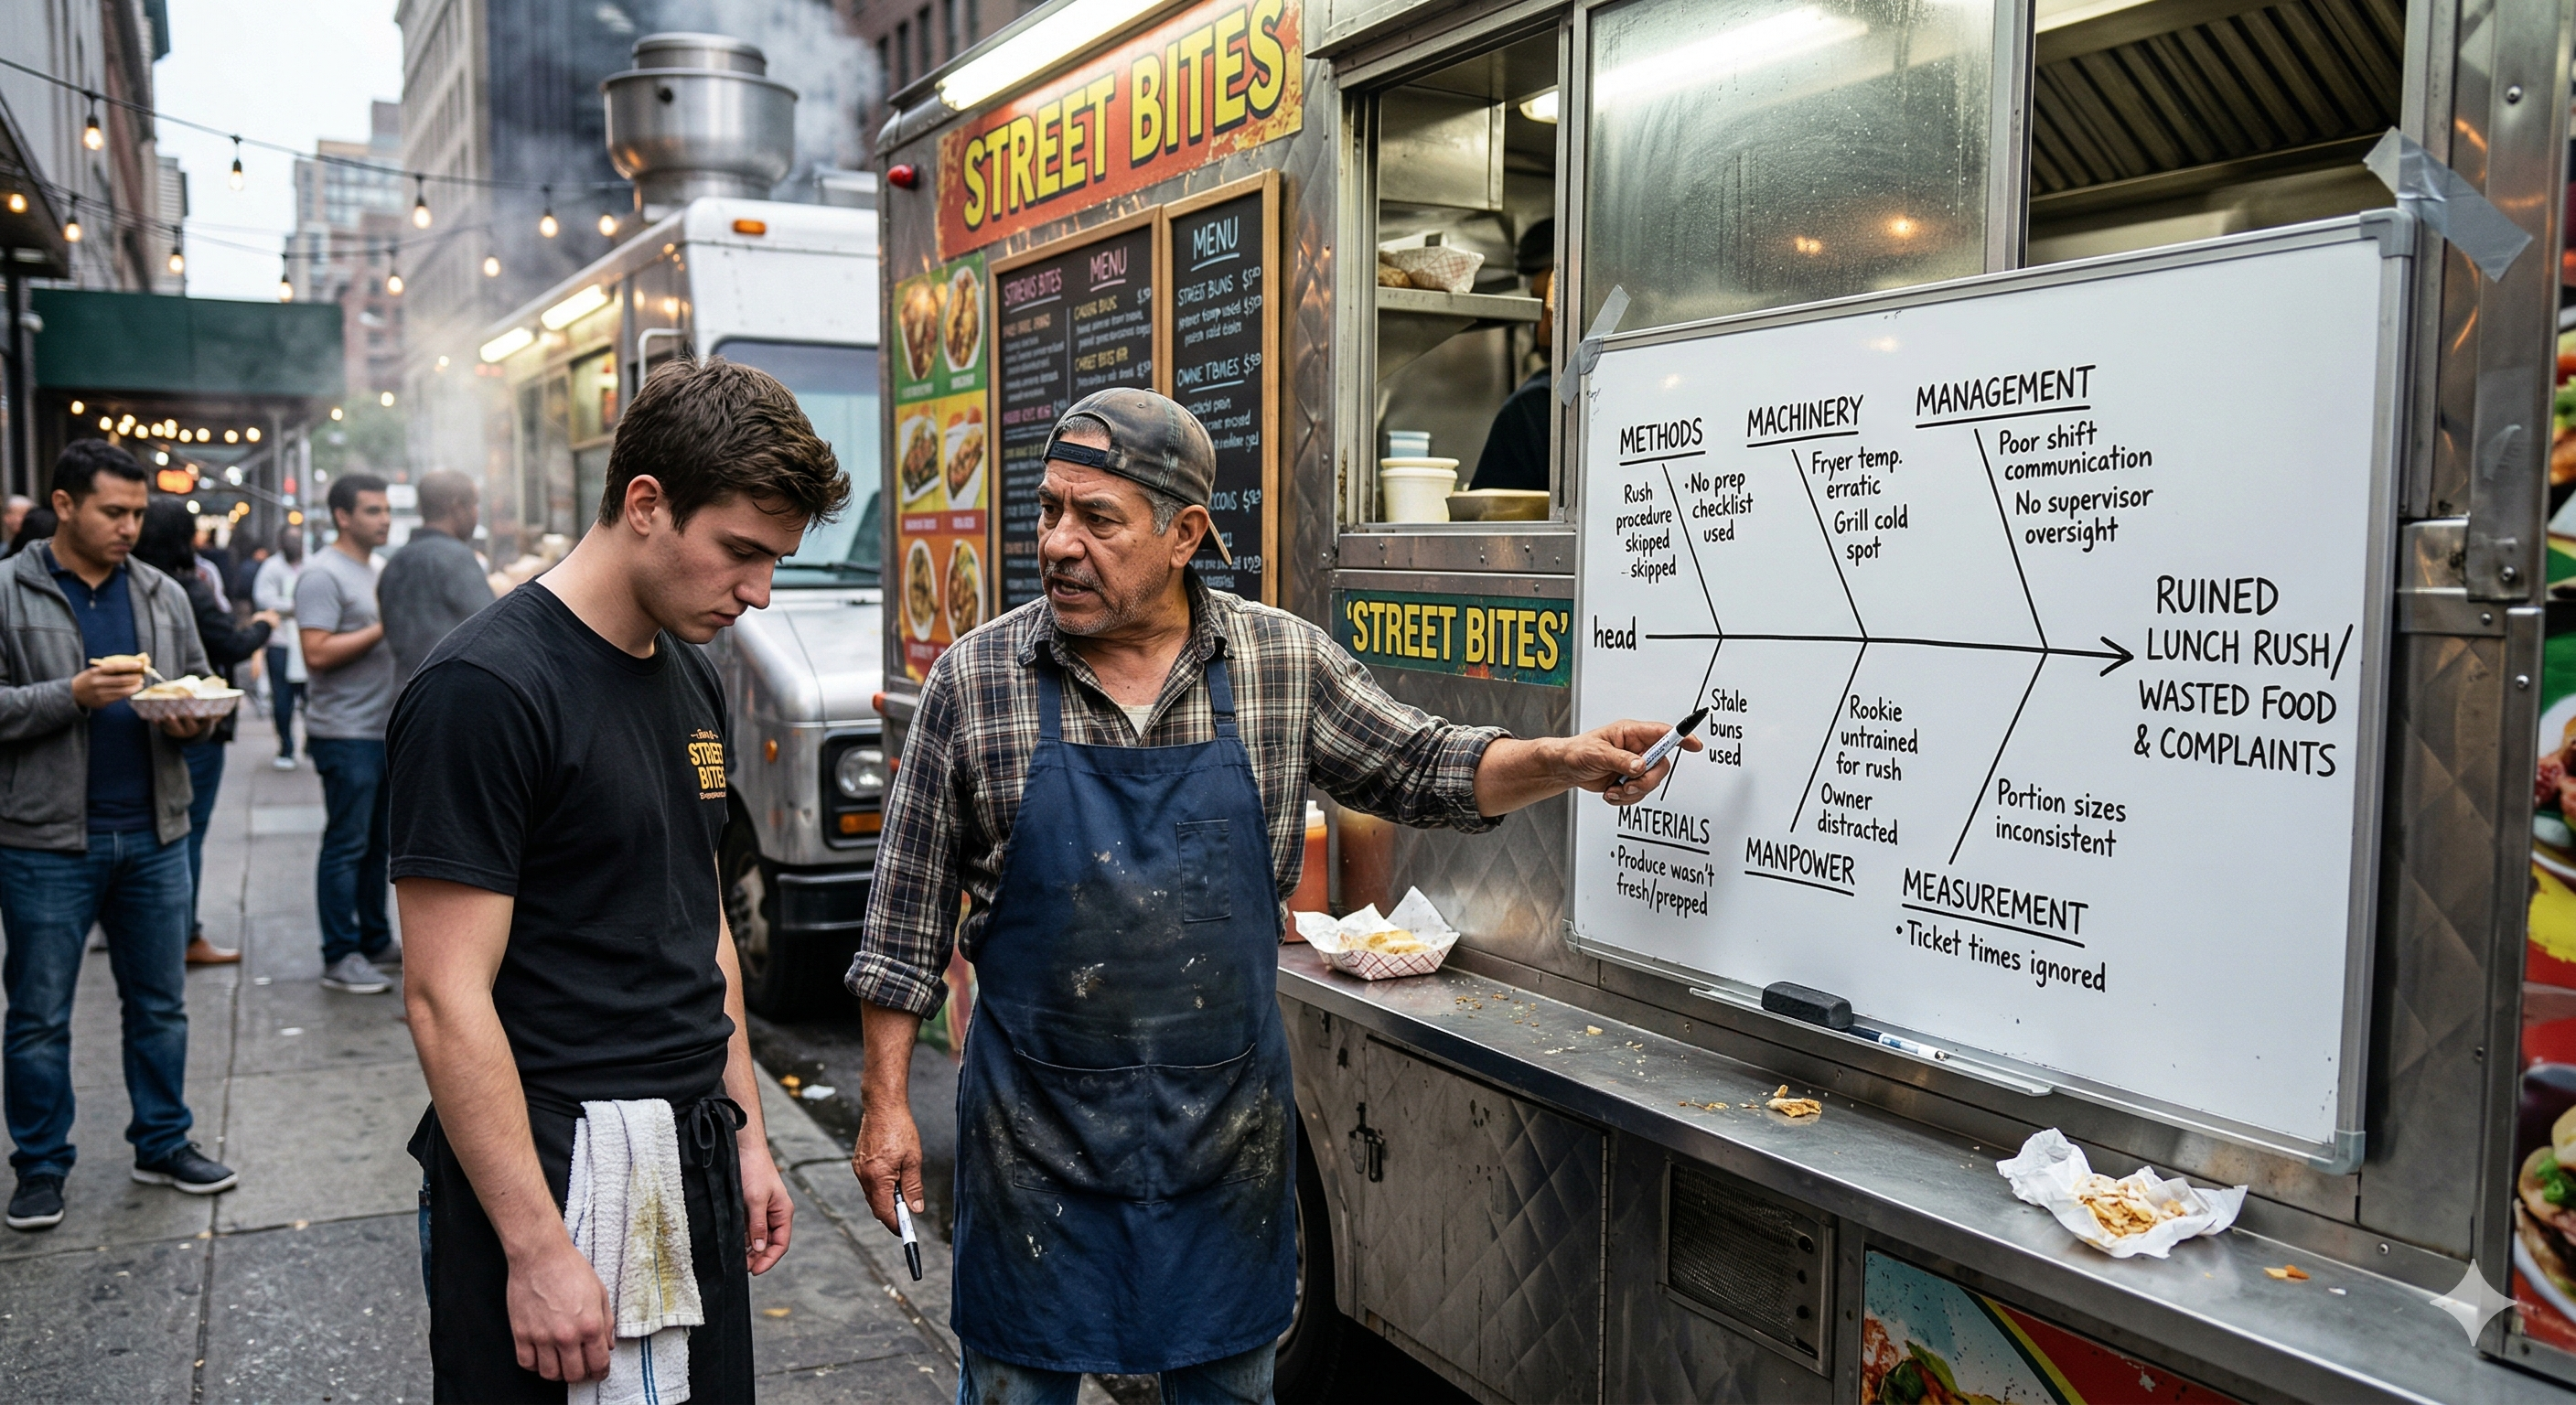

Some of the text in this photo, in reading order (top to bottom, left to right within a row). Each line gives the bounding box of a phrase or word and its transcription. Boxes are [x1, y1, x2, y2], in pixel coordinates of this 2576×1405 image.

[962, 0, 1285, 231] STREET BITES
[1193, 216, 1239, 260] MENU
[1089, 246, 1127, 283] MENU
[1208, 274, 1234, 299] BUNS
[1916, 365, 2096, 416] MANAGEMENT
[1747, 395, 1863, 437] MACHINERY
[1621, 418, 1702, 455] METHODS
[2000, 421, 2097, 455] Poor shift
[1813, 446, 1903, 481] Fryer temp.
[2005, 447, 2152, 480] communication
[1625, 482, 1652, 504] Rush
[1691, 472, 1744, 499] No prep
[1827, 476, 1881, 499] erratic
[2016, 487, 2153, 518] No supervisor
[1616, 505, 1671, 535] procedure
[1692, 493, 1753, 518] checklist
[1835, 504, 1908, 534] Grill cold
[1626, 528, 1670, 556] skipped
[1703, 519, 1734, 543] used
[2025, 517, 2119, 552] oversight
[1630, 554, 1676, 584] skipped
[1846, 536, 1882, 567] spot
[2157, 575, 2278, 616] RUINED
[1594, 615, 1637, 650] head
[2148, 624, 2353, 681] LUNCH RUSH/
[1712, 689, 1746, 713] Stale
[1851, 695, 1902, 722] Rookie
[2140, 680, 2336, 724] WASTED FOOD
[1710, 713, 1743, 740] buns
[1841, 728, 1917, 754] untrained
[1709, 743, 1742, 767] used
[1837, 751, 1901, 780] for rush
[2134, 724, 2335, 777] & COMPLAINTS
[1821, 783, 1873, 811] Owner
[1997, 778, 2126, 822] Portion sizes
[1618, 805, 1709, 845] MATERIALS
[1818, 810, 1897, 845] distracted
[1997, 816, 2116, 857] inconsistent
[1618, 849, 1714, 887] Produce wasn't
[1745, 837, 1854, 885] MANPOWER
[1617, 874, 1707, 918] fresh/prepped
[1904, 868, 2088, 935] MEASUREMENT
[1907, 920, 2105, 992] Ticket times ignored
